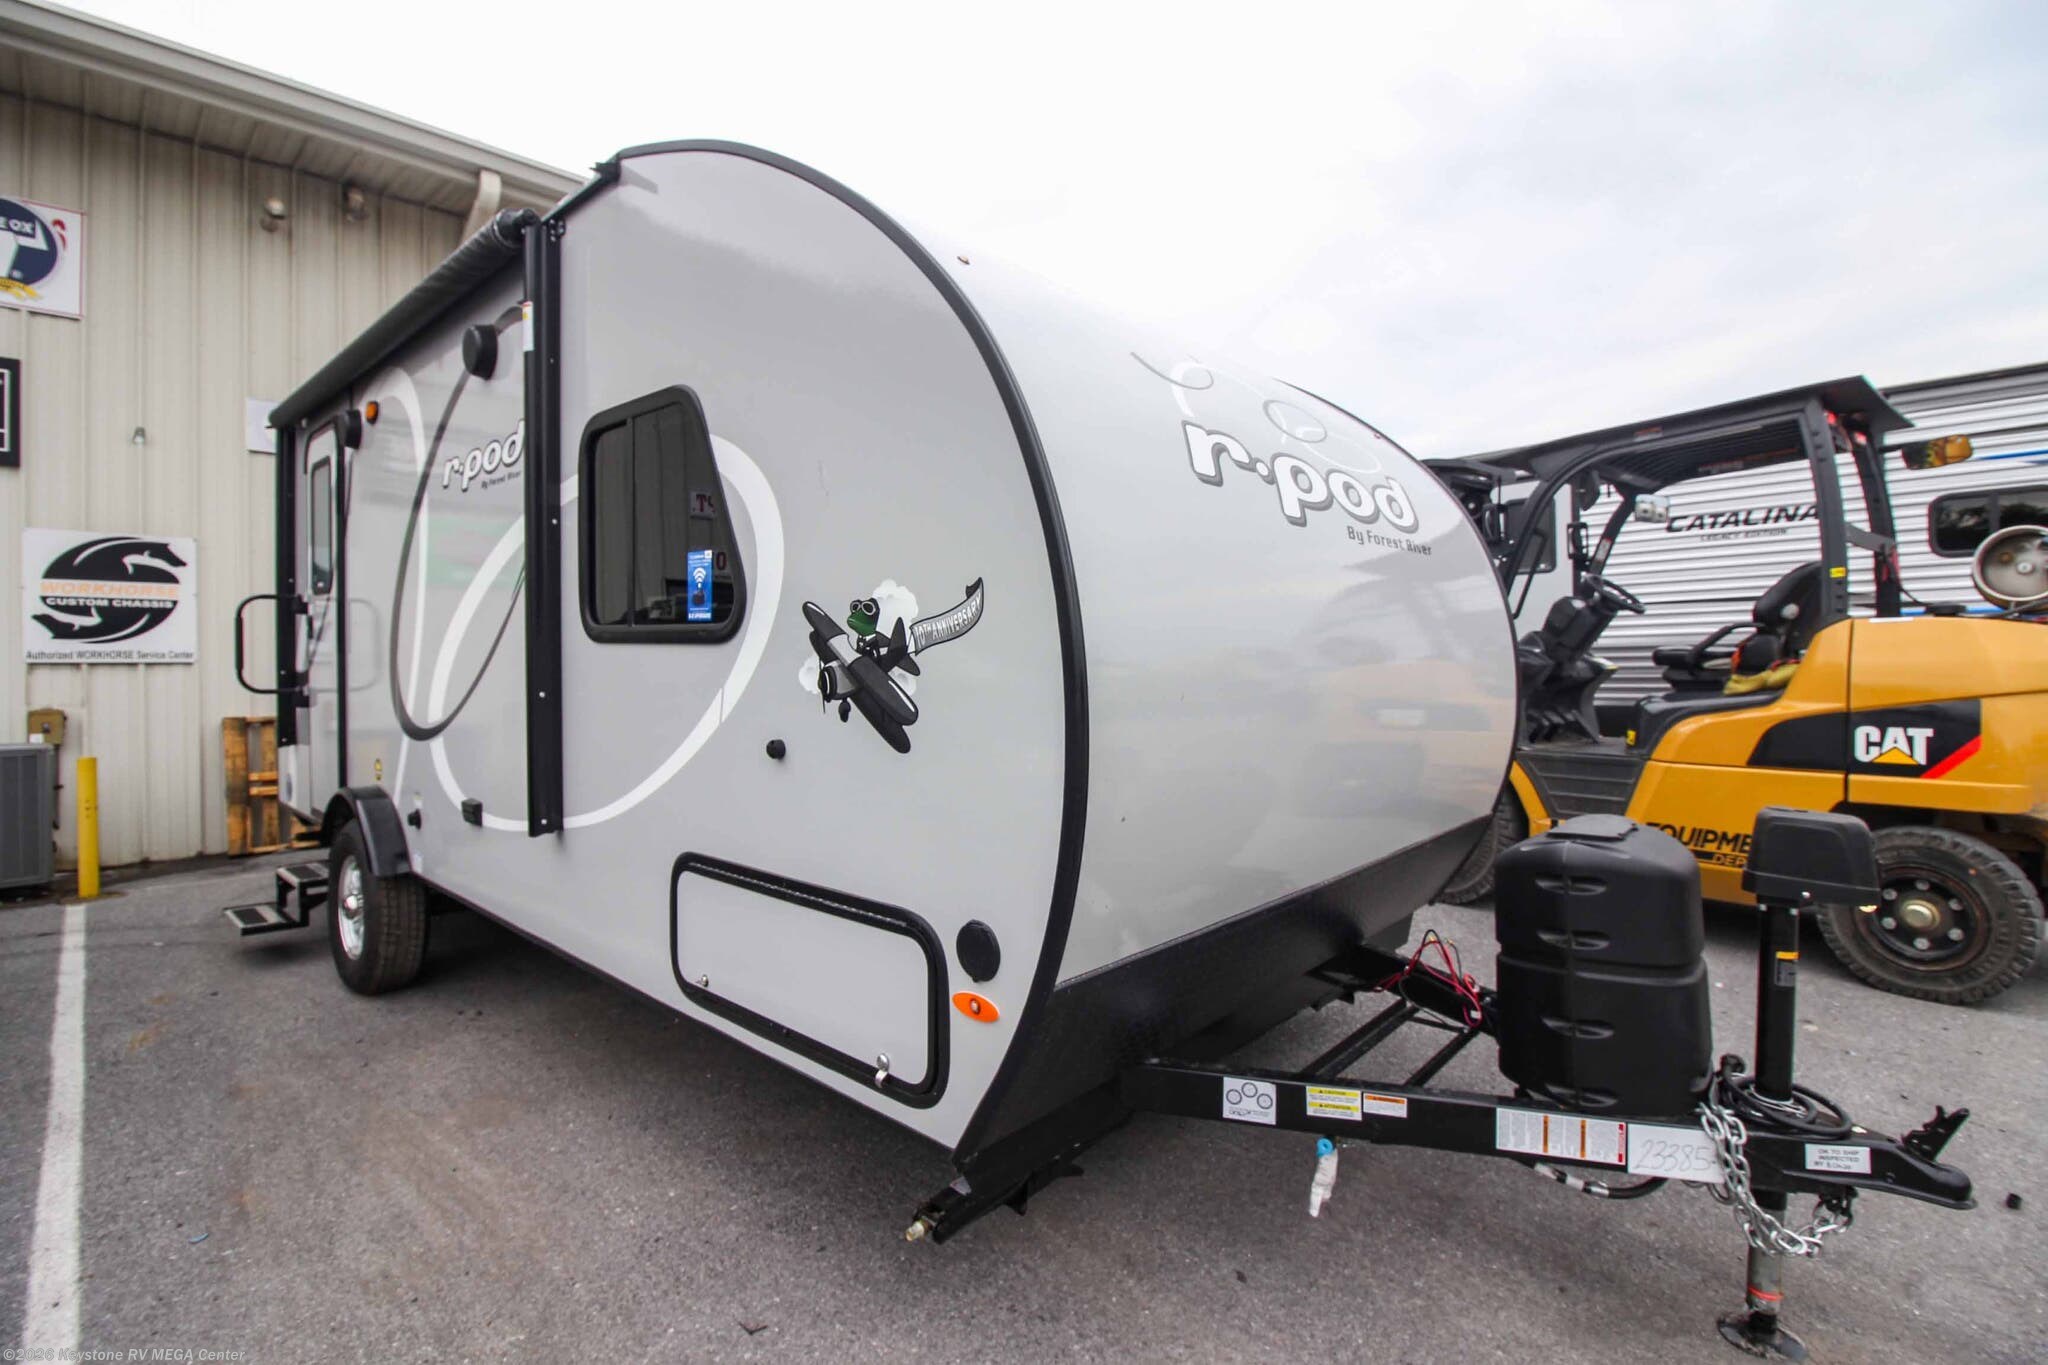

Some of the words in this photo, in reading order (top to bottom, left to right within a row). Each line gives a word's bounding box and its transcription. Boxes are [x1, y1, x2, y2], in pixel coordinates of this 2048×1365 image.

[8, 218, 36, 235] OX
[1666, 505, 1820, 533] CATALINA
[1347, 525, 1364, 546] By
[1366, 530, 1403, 551] Forest
[1407, 538, 1433, 557] River
[40, 581, 180, 598] WORKHORSE
[46, 597, 109, 607] CUSTOM
[112, 598, 174, 609] CHASSIS
[26, 650, 73, 660] Authorized
[76, 650, 134, 660] WORKHORSE
[137, 650, 166, 660] Service
[169, 650, 193, 660] Center
[1853, 725, 1935, 766] CAT
[1712, 853, 1746, 867] DEP
